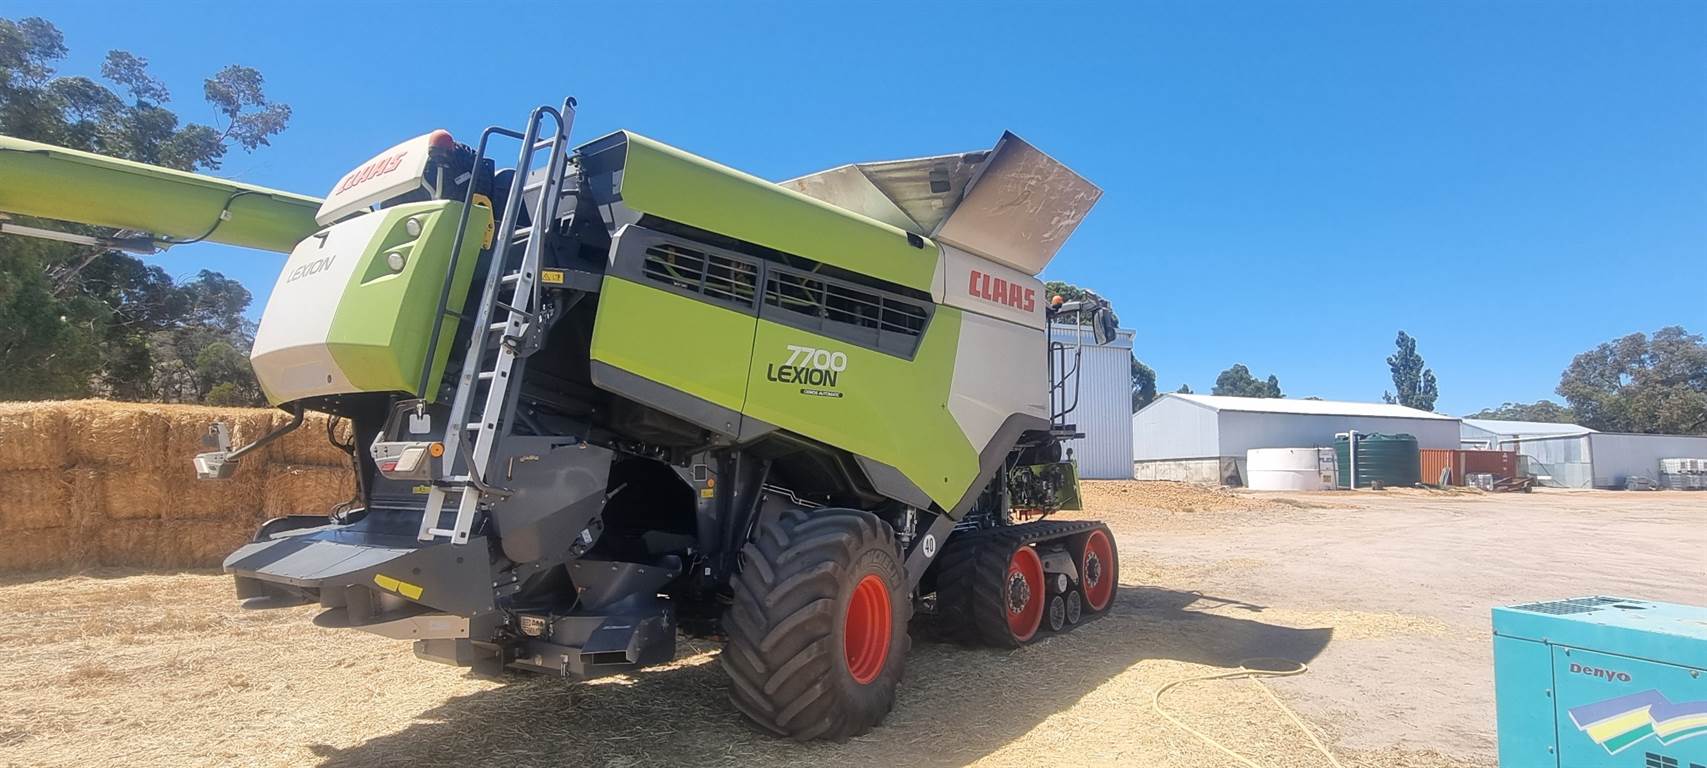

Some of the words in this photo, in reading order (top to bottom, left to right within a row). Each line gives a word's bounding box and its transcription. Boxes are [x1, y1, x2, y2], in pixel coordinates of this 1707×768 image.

[336, 152, 407, 195] CLAAS
[287, 255, 336, 283] LEXION
[969, 270, 1035, 312] CLAAS
[784, 344, 848, 371] 7700
[767, 363, 838, 387] LEXION
[925, 537, 934, 553] 40
[1569, 663, 1631, 682] Denyo
